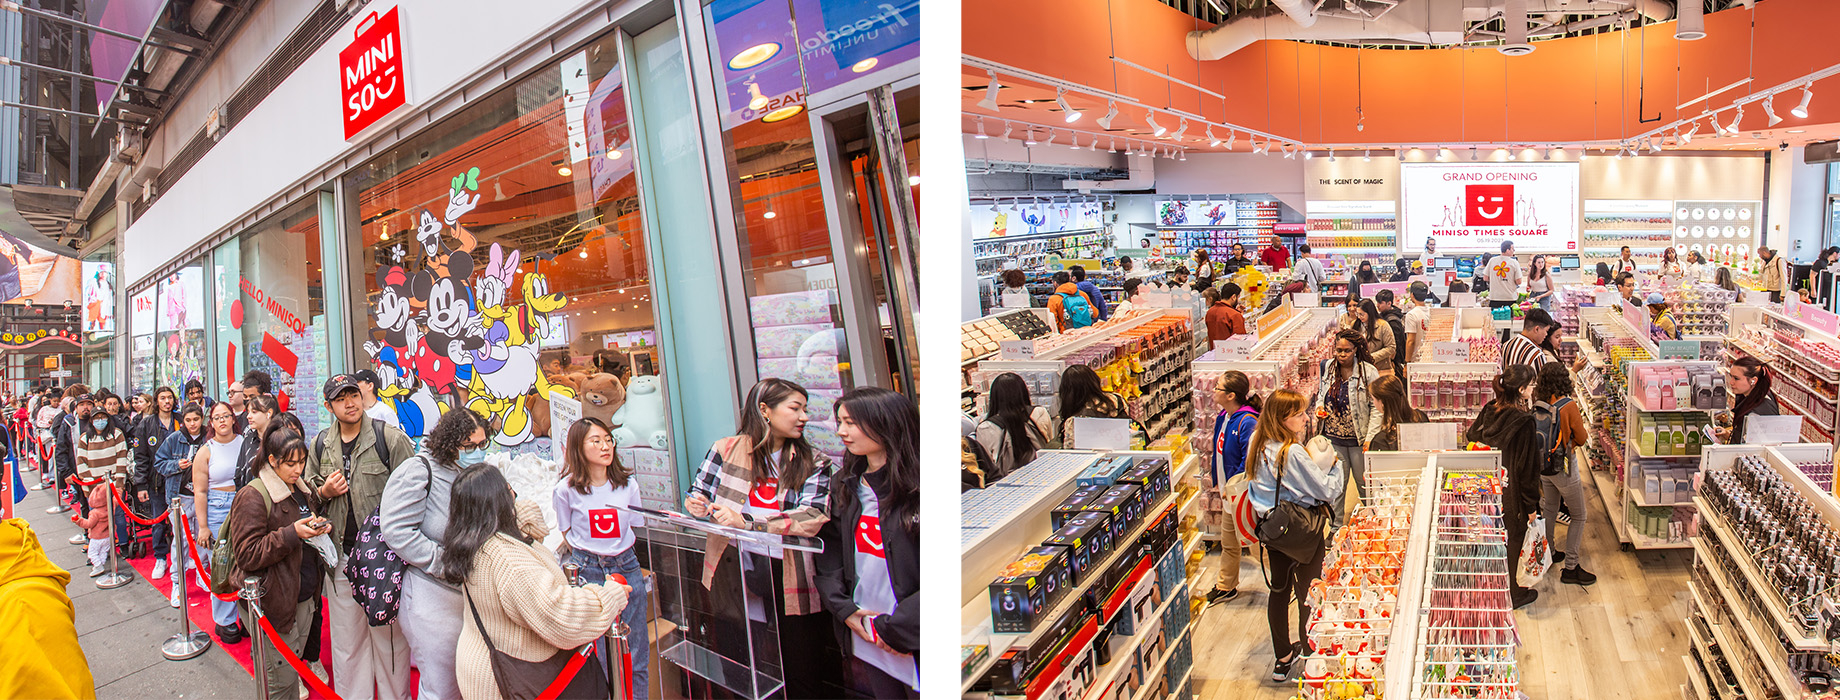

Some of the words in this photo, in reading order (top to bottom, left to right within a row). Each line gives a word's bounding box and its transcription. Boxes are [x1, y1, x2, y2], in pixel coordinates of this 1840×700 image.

[346, 32, 394, 90] MINI
[1443, 172, 1482, 181] GRAND
[1486, 172, 1538, 181] OPENING
[238, 275, 264, 308] HELLO,
[266, 296, 306, 338] MINISO!
